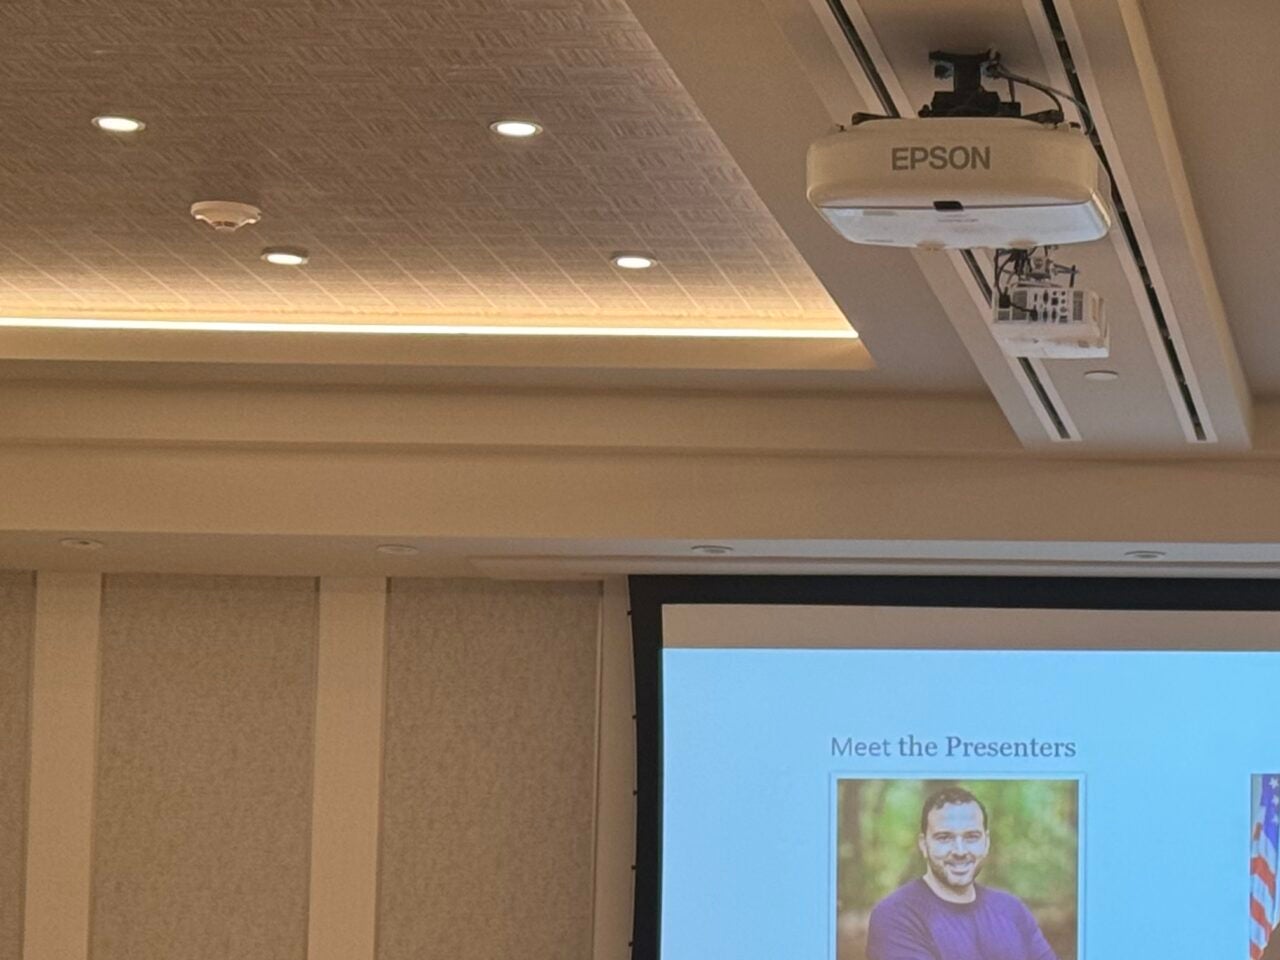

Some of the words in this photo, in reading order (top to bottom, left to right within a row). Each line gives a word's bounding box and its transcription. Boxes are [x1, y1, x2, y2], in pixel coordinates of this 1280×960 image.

[891, 145, 992, 171] EPSON
[831, 736, 891, 757] Meet
[898, 734, 938, 757] the
[945, 735, 1077, 757] Presenters
